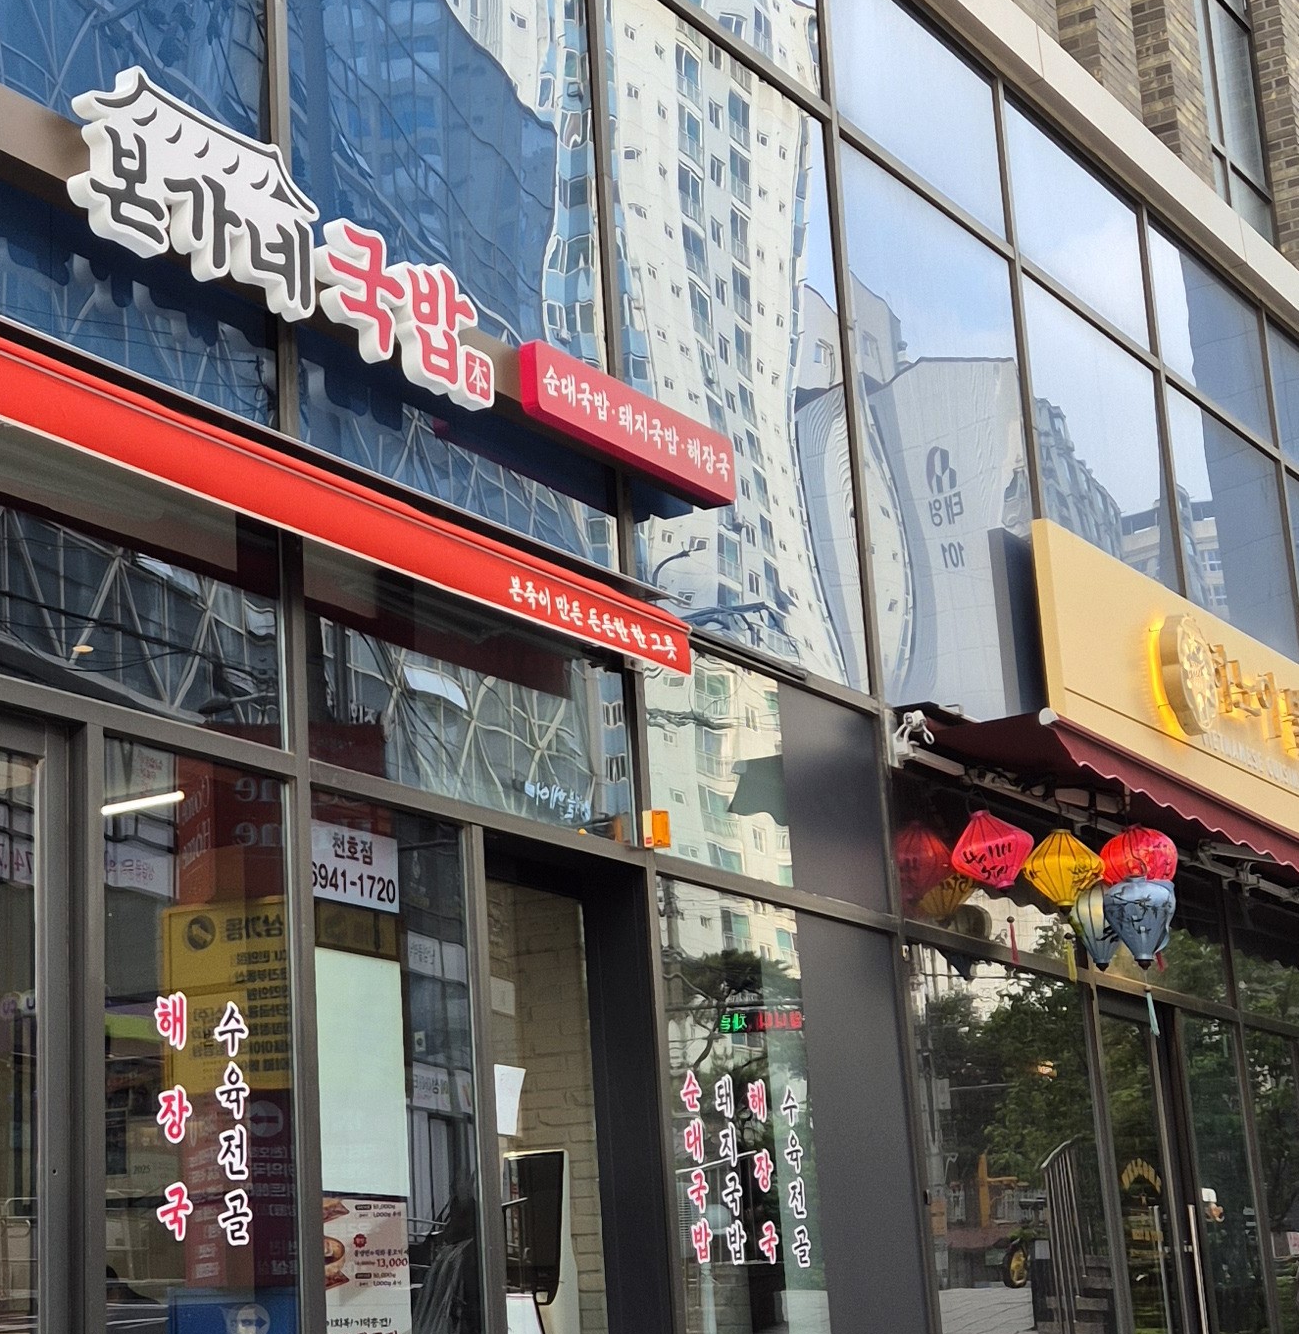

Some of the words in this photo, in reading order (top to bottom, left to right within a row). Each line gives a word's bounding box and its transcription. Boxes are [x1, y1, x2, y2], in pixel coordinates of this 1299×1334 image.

[90, 124, 312, 305] 본가네
[328, 223, 476, 387] 국밥
[508, 575, 551, 616] 본죽이
[555, 593, 584, 627] 만든
[587, 608, 631, 644] 든든한
[630, 623, 648, 650] 한
[650, 633, 678, 662] 그릇
[331, 831, 374, 866] 천호점
[154, 991, 193, 1241] 해장국
[214, 1002, 253, 1247] 수육전골
[680, 1069, 713, 1263] 순대국밥
[715, 1074, 747, 1265] 돼지국밥
[748, 1079, 779, 1264] 해장국
[781, 1085, 811, 1267] 수육전골
